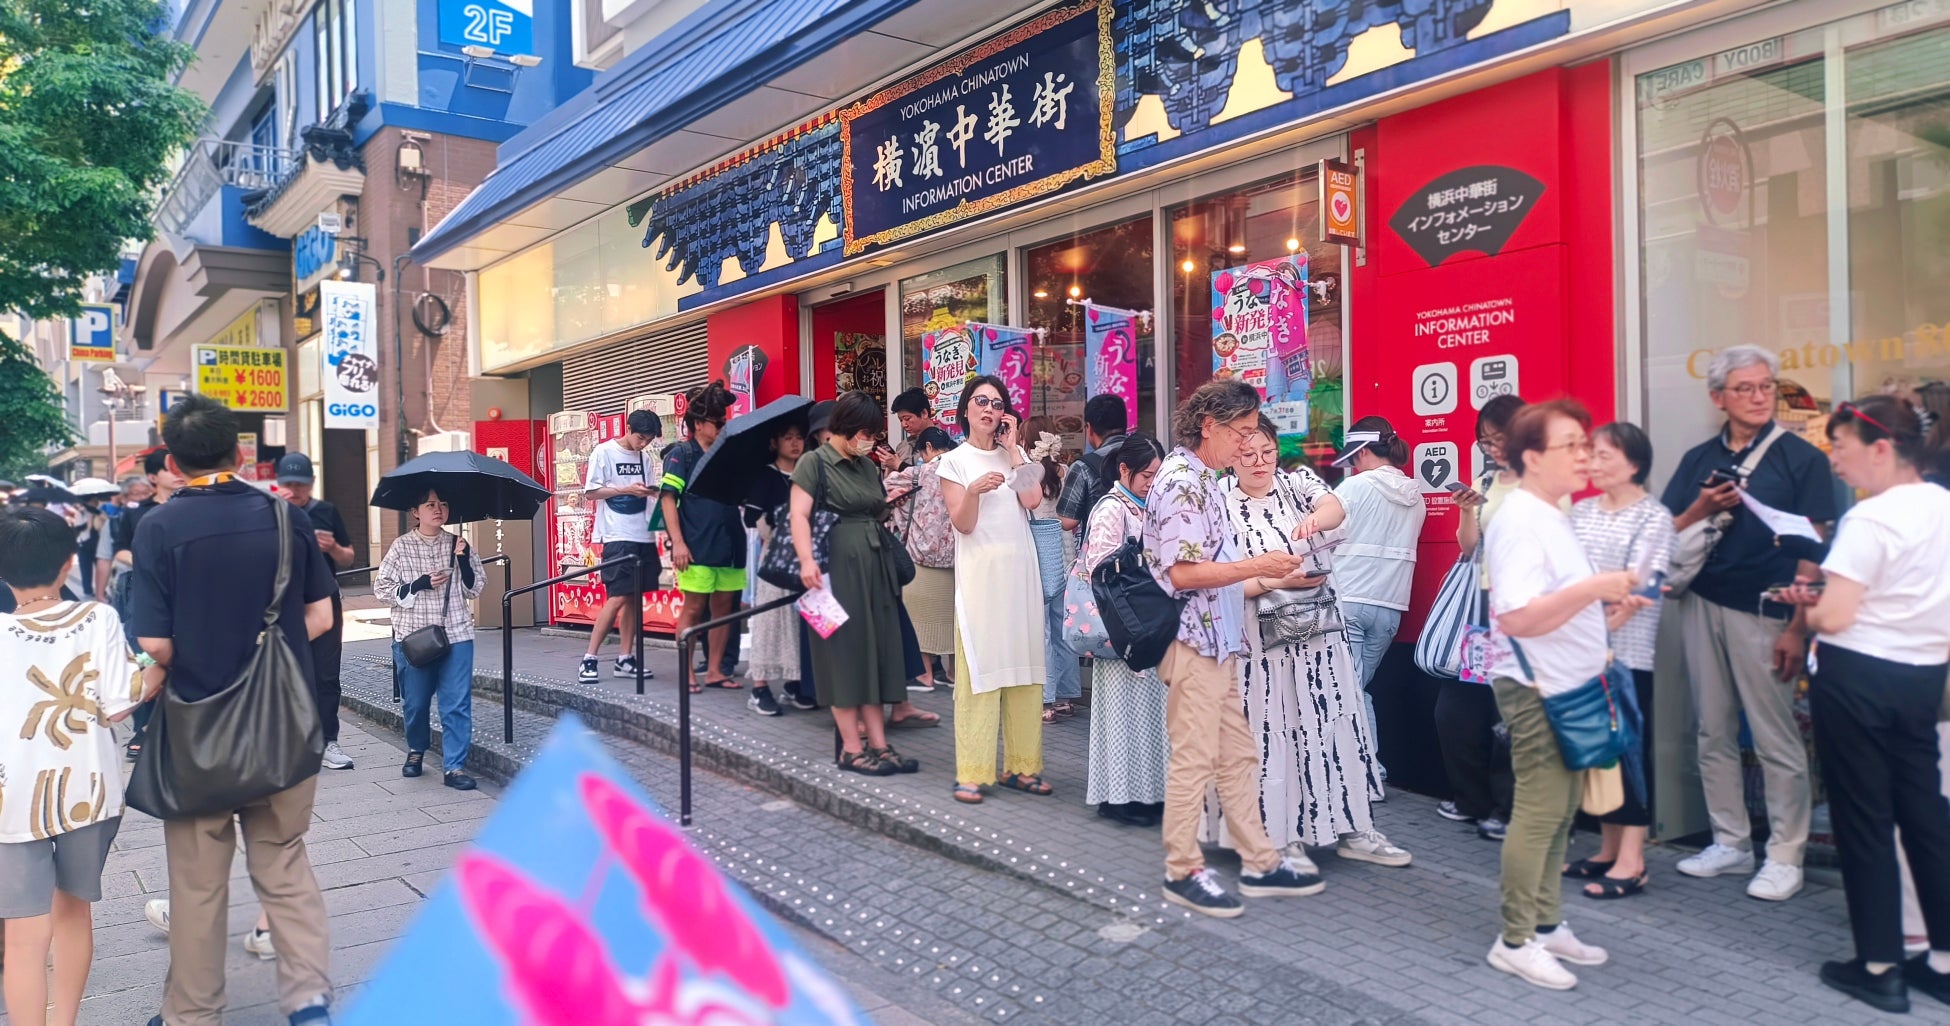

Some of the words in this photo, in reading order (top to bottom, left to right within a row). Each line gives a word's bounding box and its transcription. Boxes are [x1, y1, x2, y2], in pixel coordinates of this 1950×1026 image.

[463, 4, 514, 45] 2F
[900, 89, 959, 121] YOKOHAMA
[960, 52, 1029, 95] CHINATOWN
[902, 174, 983, 214] INFORMATION
[985, 154, 1034, 185] CENTER
[1330, 170, 1352, 186] AED
[1427, 178, 1498, 210] 横浜中華街
[1407, 195, 1524, 233] インフォメーション
[1437, 223, 1492, 245] センター
[1414, 309, 1515, 337] INFORMATION
[1416, 306, 1461, 320] YOKOHAMA
[1462, 298, 1513, 313] CHINATOWN
[75, 310, 109, 344] P
[1437, 329, 1490, 349] CENTER
[1686, 335, 1905, 380] Catown
[328, 403, 376, 417] GiGO
[1425, 447, 1447, 457] AED
